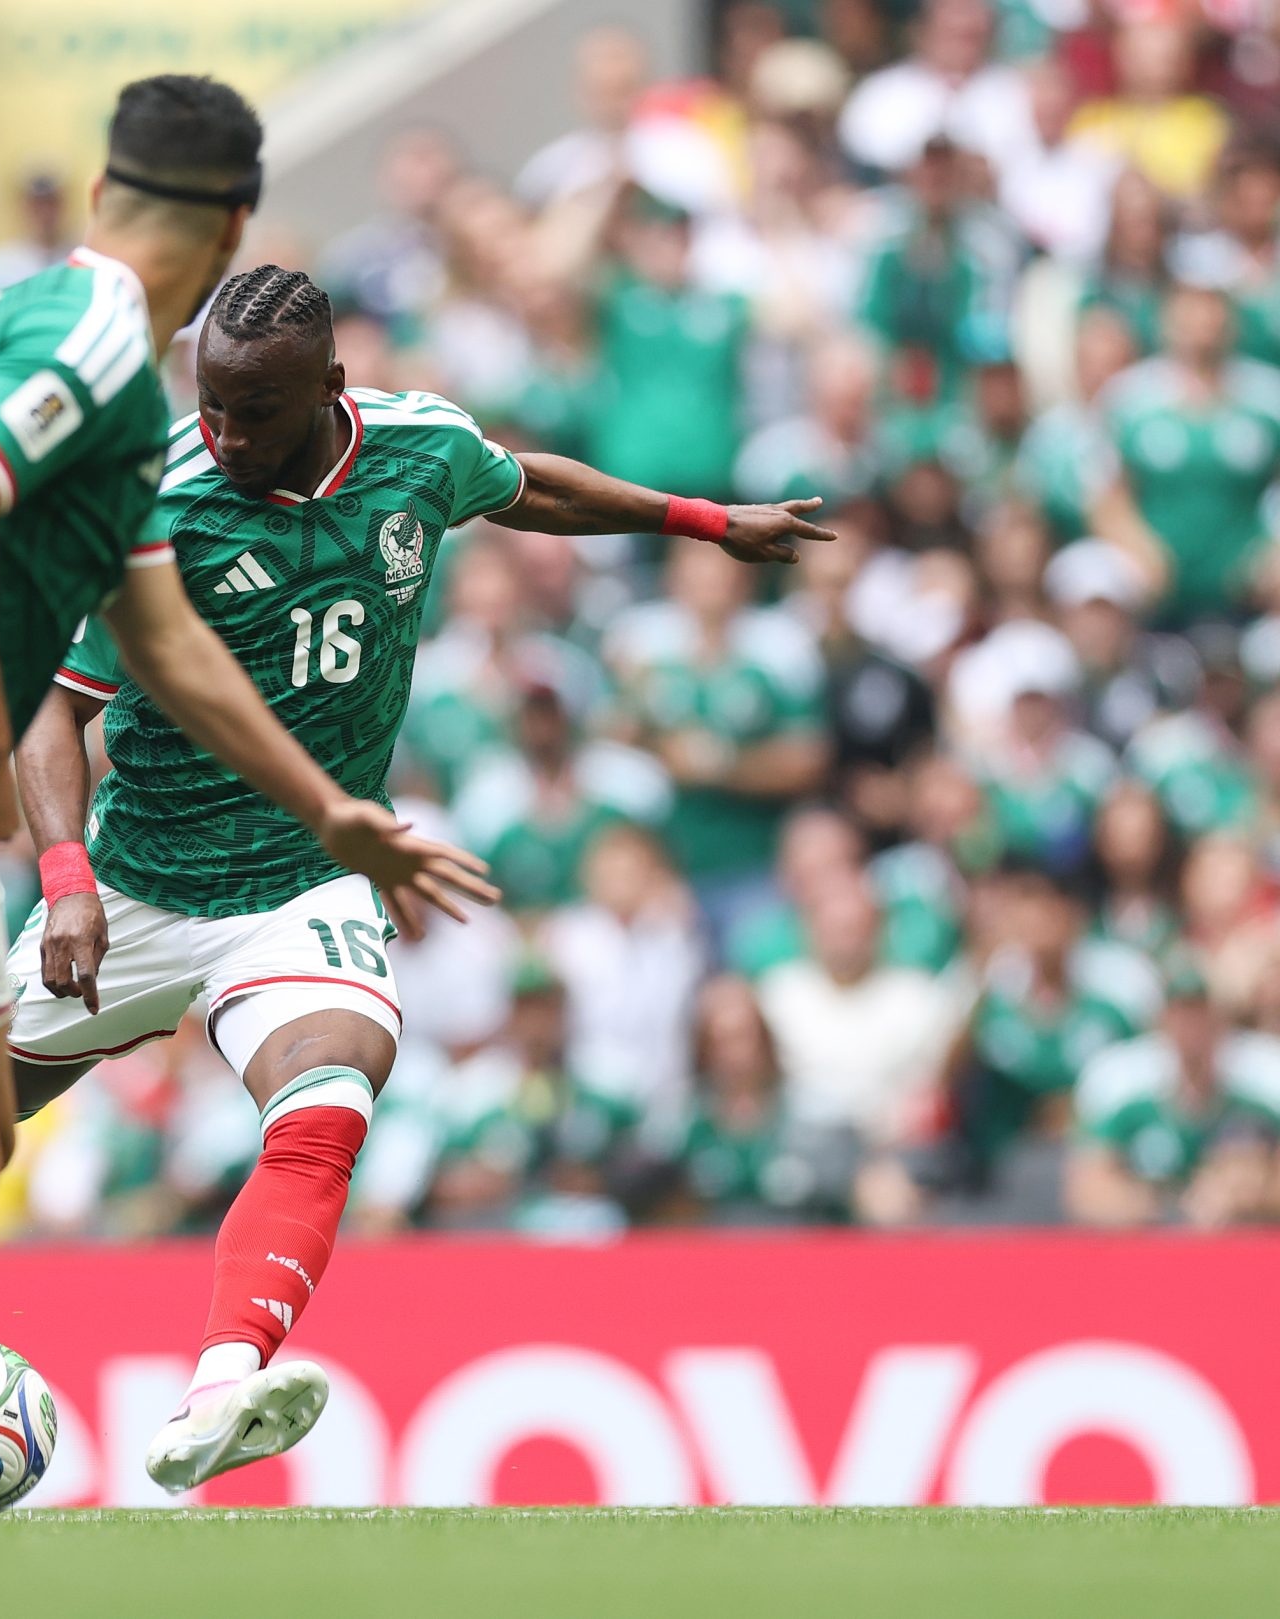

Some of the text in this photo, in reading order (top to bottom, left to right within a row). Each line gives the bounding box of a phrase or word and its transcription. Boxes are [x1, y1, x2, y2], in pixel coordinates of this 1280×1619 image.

[386, 563, 422, 582] MÉXICO
[290, 599, 365, 687] 16
[307, 918, 387, 978] 16
